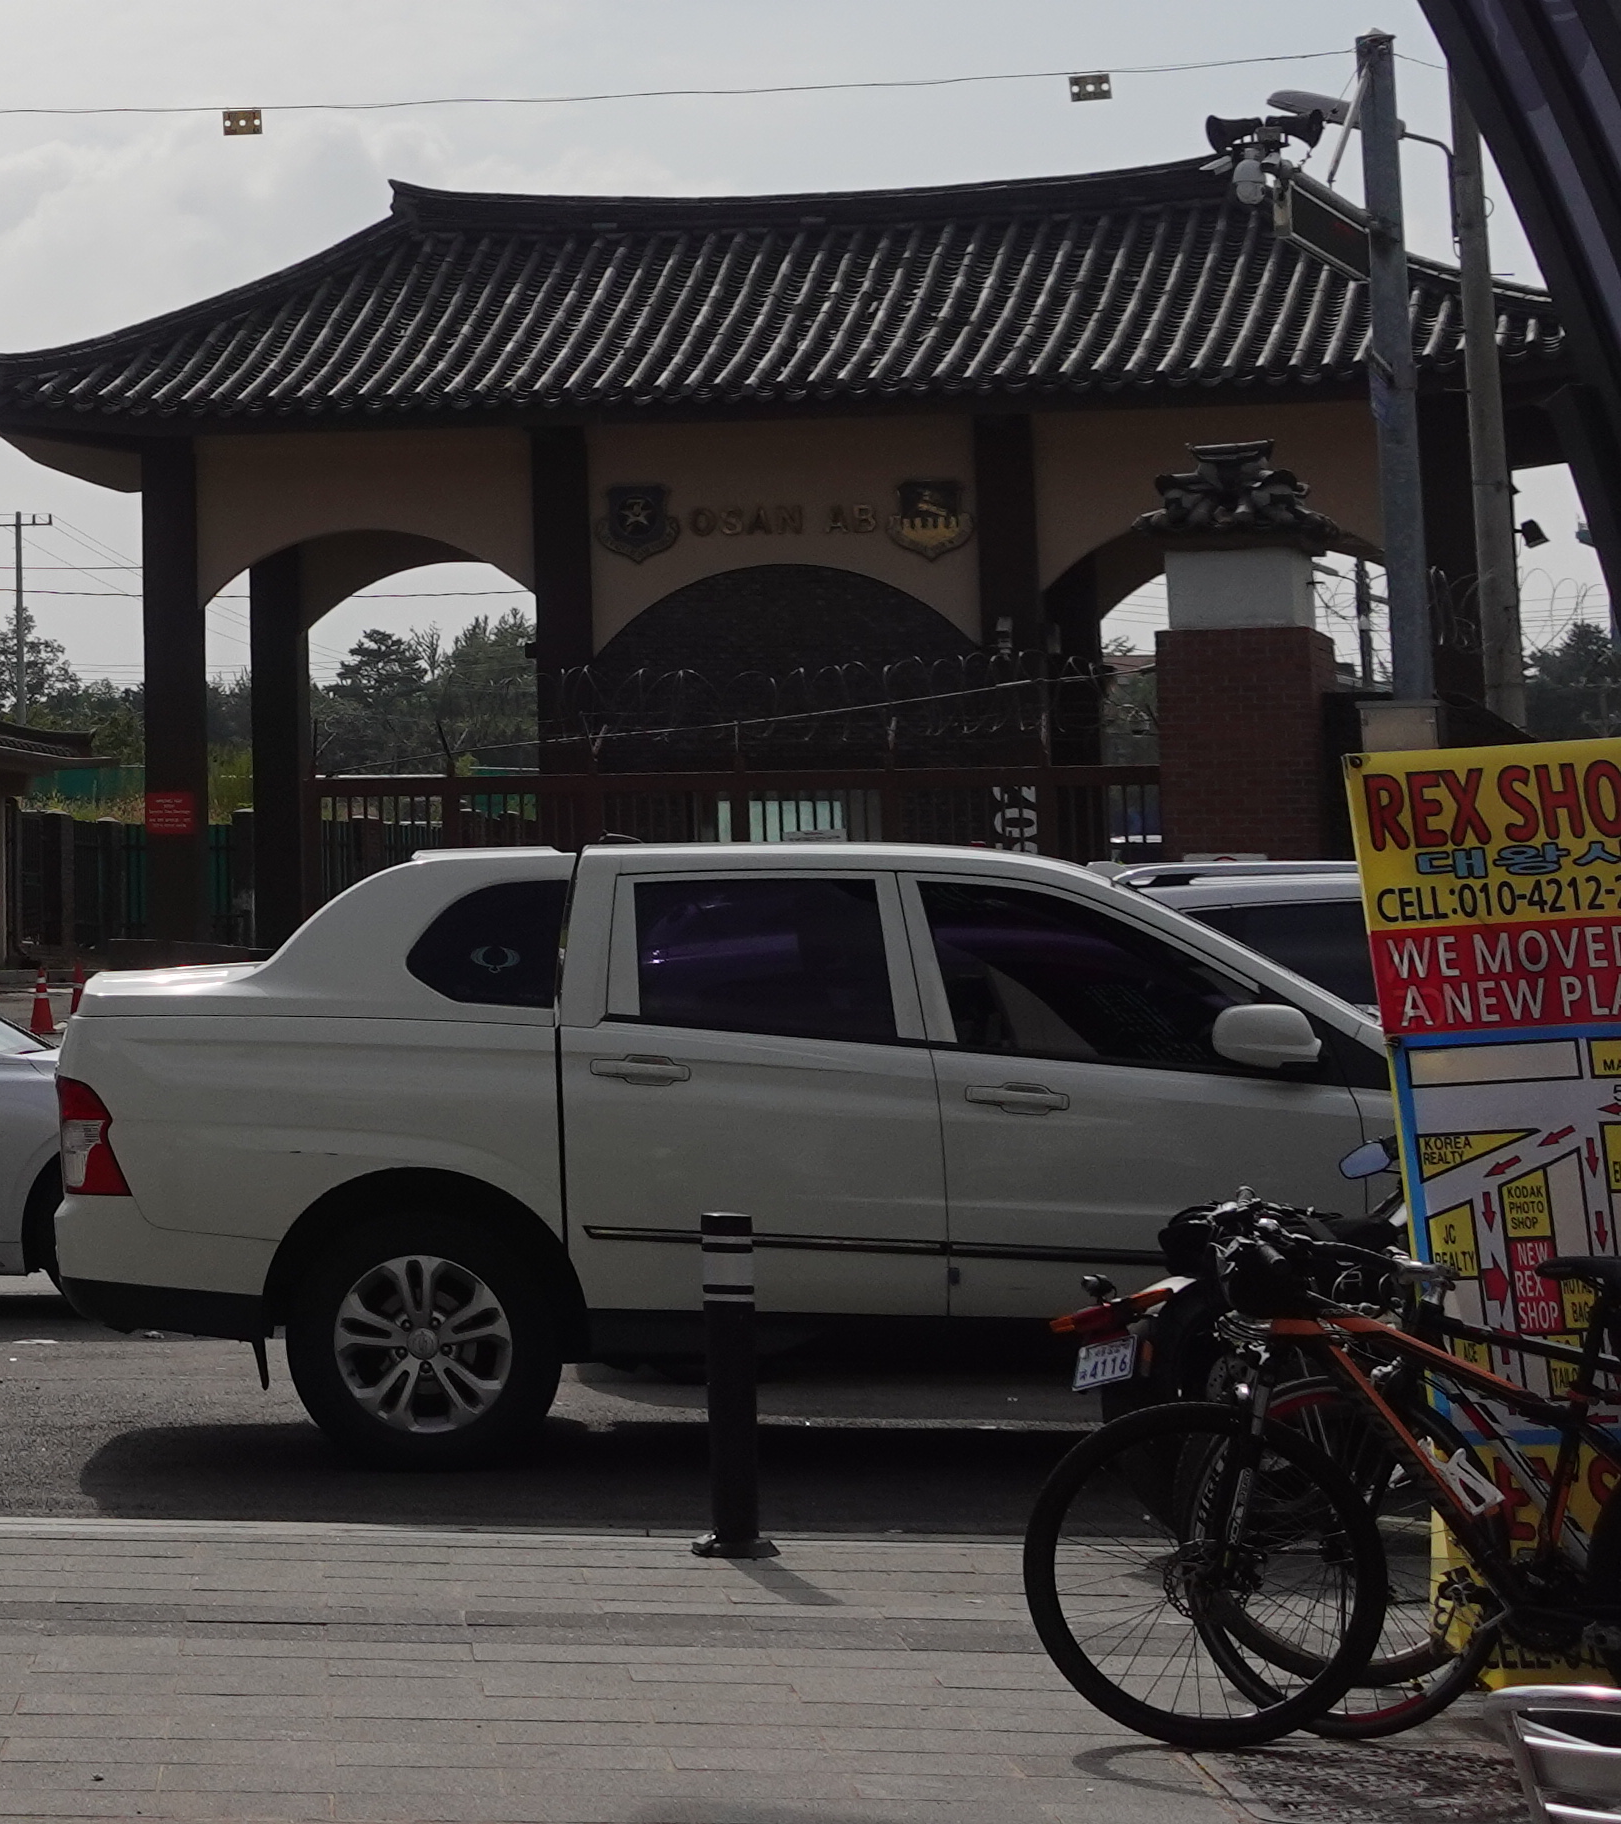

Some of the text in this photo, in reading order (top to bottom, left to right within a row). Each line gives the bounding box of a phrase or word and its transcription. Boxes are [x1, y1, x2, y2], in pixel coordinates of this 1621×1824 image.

[689, 503, 877, 537] OSAN AB
[1363, 768, 1491, 852] REX
[1377, 875, 1621, 923] CELL:010-4212-
[1386, 935, 1461, 979] WE
[1400, 985, 1434, 1027] A
[1442, 977, 1545, 1024] NEW
[1424, 1136, 1473, 1151] KOREA
[1423, 1151, 1465, 1165] REALTY
[1507, 1185, 1544, 1199] KODAK
[1509, 1200, 1544, 1215] PHOTO
[1443, 1224, 1457, 1245] JC
[1511, 1216, 1539, 1230] SHOP
[1516, 1241, 1549, 1266] NEW
[1514, 1270, 1545, 1297] REX
[1518, 1301, 1558, 1329] SHOP
[1090, 1354, 1127, 1379] 4116
